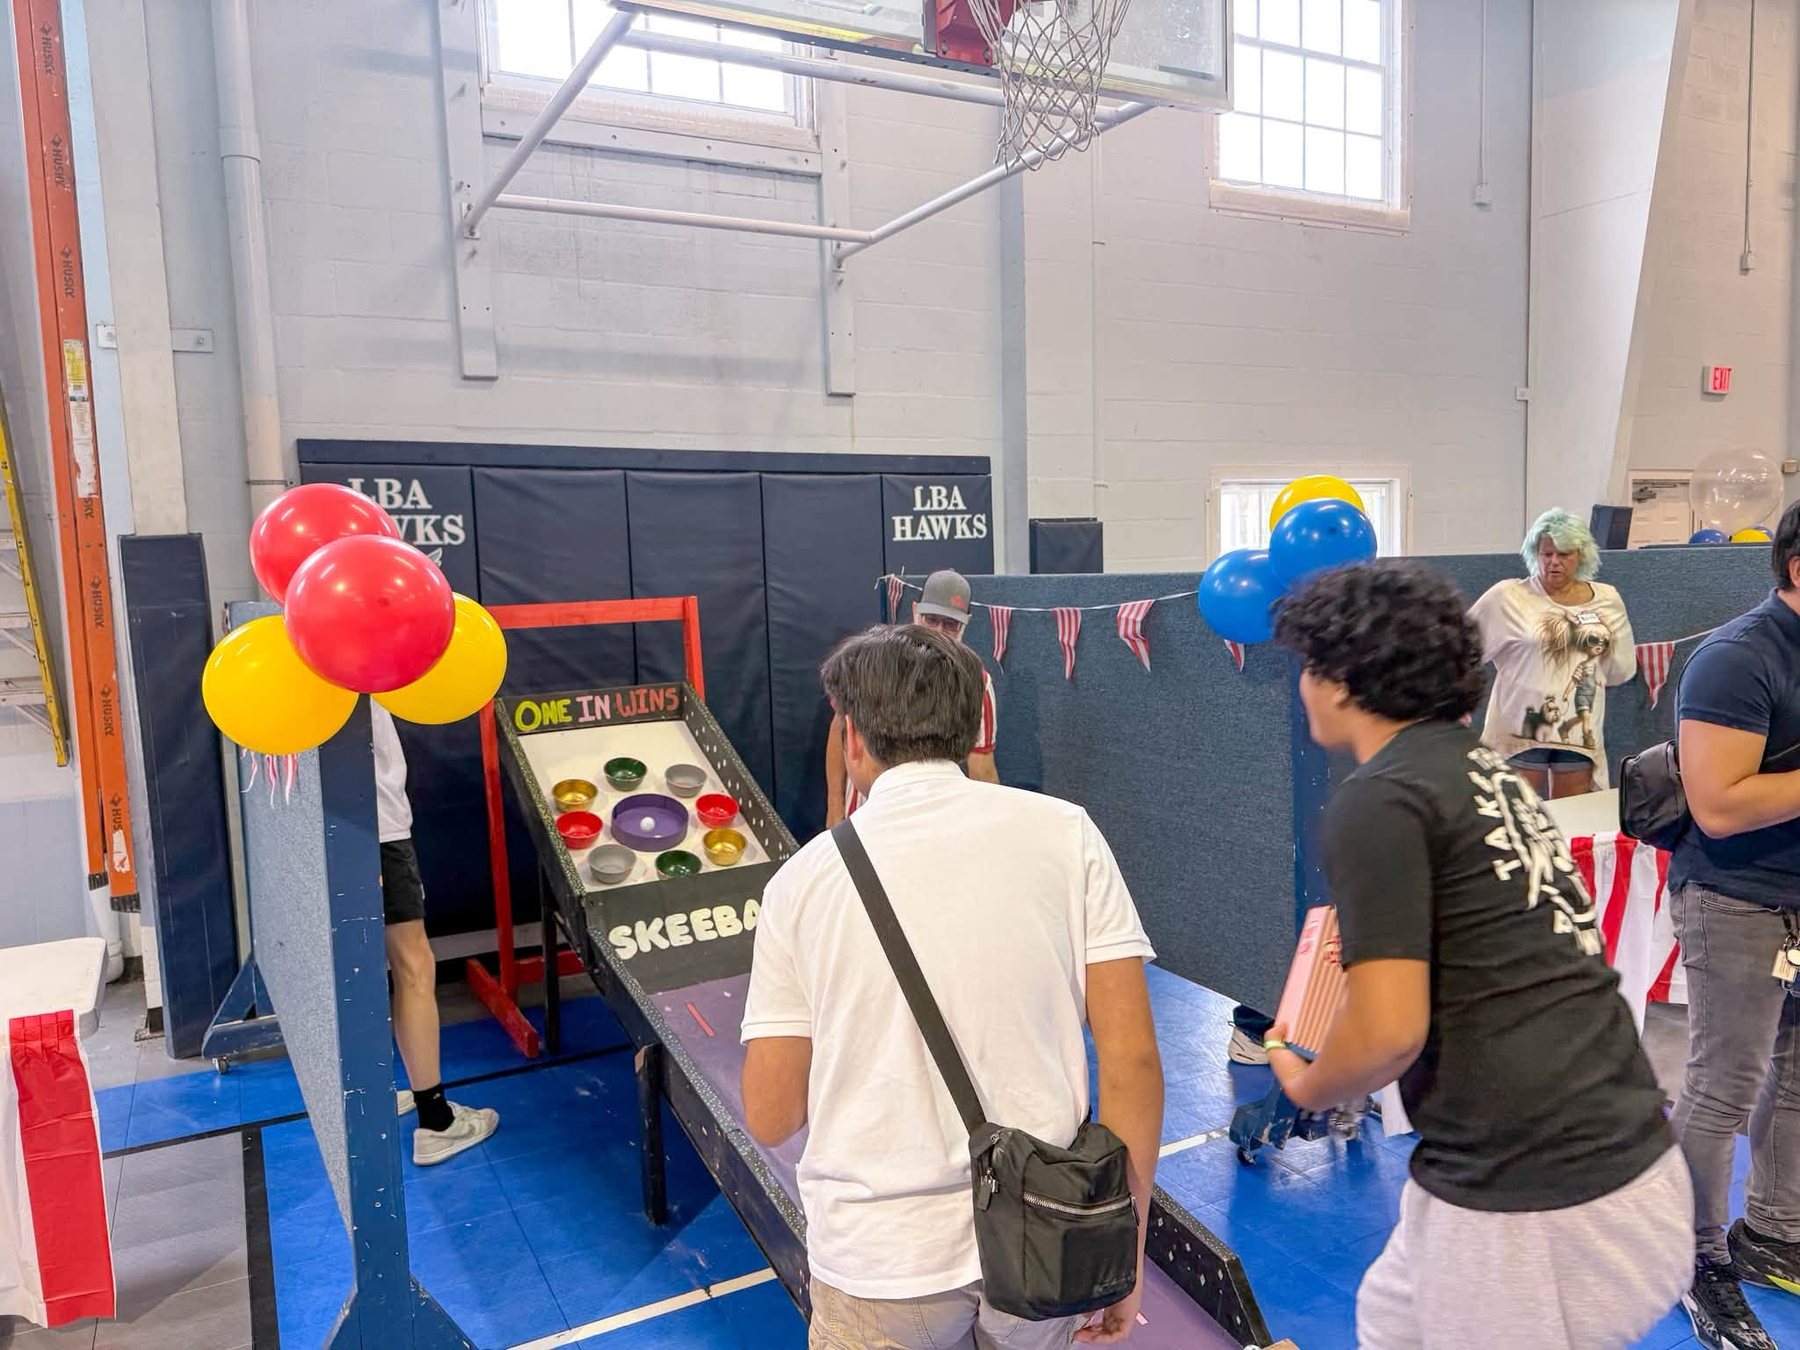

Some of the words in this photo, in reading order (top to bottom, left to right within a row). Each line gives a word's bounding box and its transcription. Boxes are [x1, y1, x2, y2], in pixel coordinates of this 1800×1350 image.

[62, 260, 75, 298] HUSKY
[1712, 366, 1732, 390] EXIT
[912, 485, 967, 511] LBA
[891, 513, 988, 541] HAWKS
[92, 590, 105, 628] HUSKY
[102, 699, 115, 737] HUSKY
[514, 698, 572, 732] ONE
[575, 694, 611, 723] IN
[615, 687, 680, 718] WINS
[608, 899, 762, 960] SKEEBA
